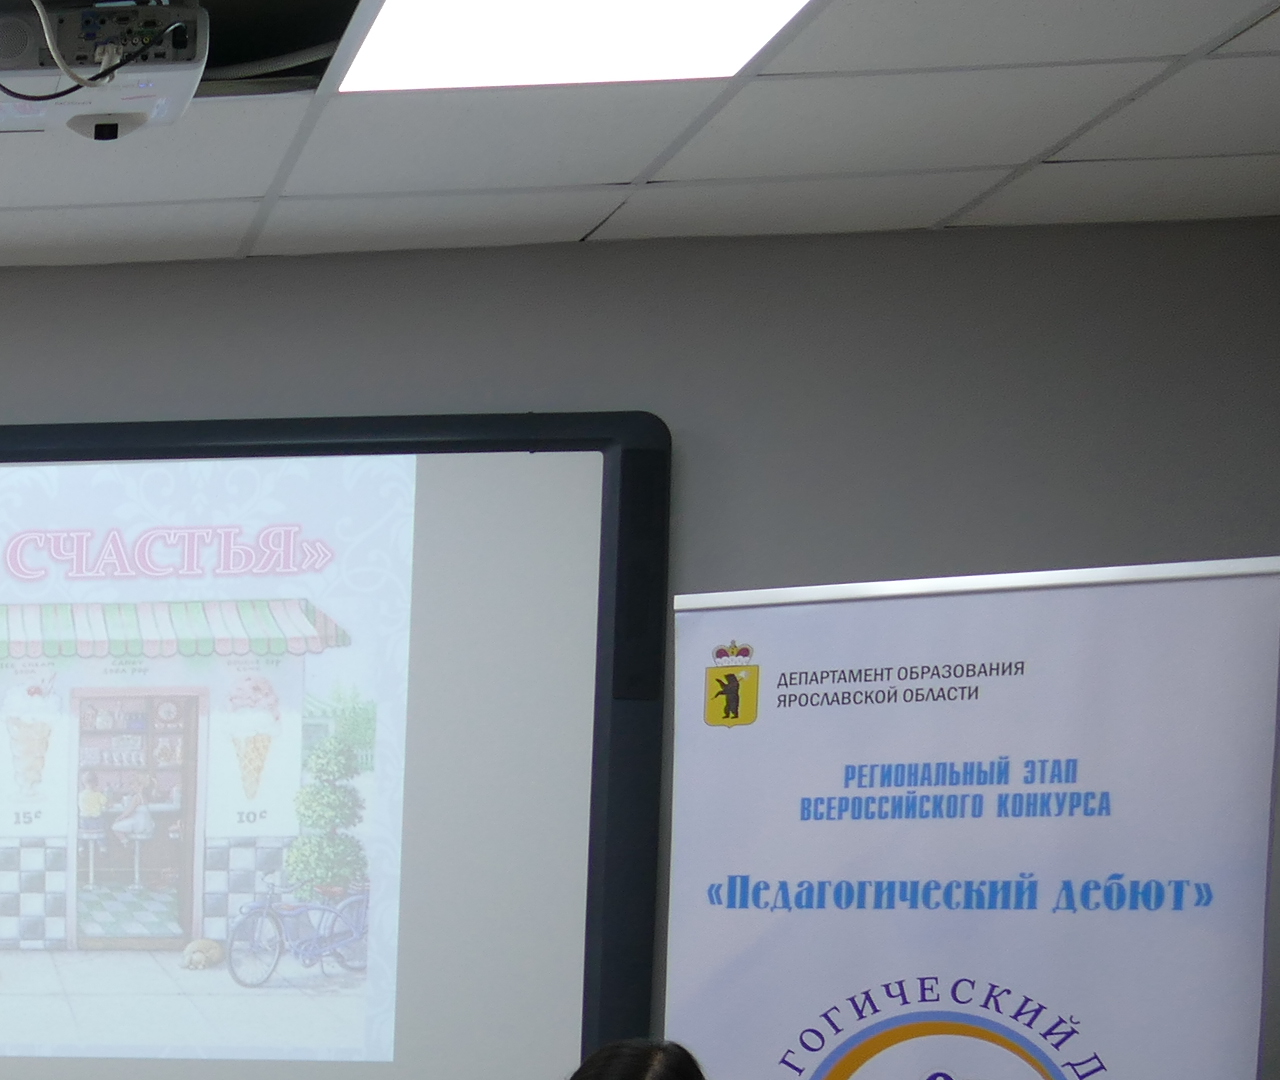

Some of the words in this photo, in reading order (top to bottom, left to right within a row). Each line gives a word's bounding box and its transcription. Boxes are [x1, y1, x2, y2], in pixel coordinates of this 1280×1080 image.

[5, 525, 333, 580] СЧАСТЬЯ»
[776, 667, 894, 690] ДЕПАРТАМЕНТ
[896, 661, 1026, 682] ОБРАЗОВАНИЯ
[776, 686, 899, 708] ЯРОСЛАВСКОЙ
[902, 686, 980, 703] ОБЛАСТИ
[843, 756, 1011, 788] РЕГИОНАЛЬНЫЙ
[1023, 758, 1079, 784] ЭТАП
[800, 790, 984, 821] ВСЕРОССИЙСКОГО
[996, 791, 1112, 818] КОНКУРСА
[706, 872, 1039, 913] «Педагогический
[1052, 873, 1215, 915] дебют»
